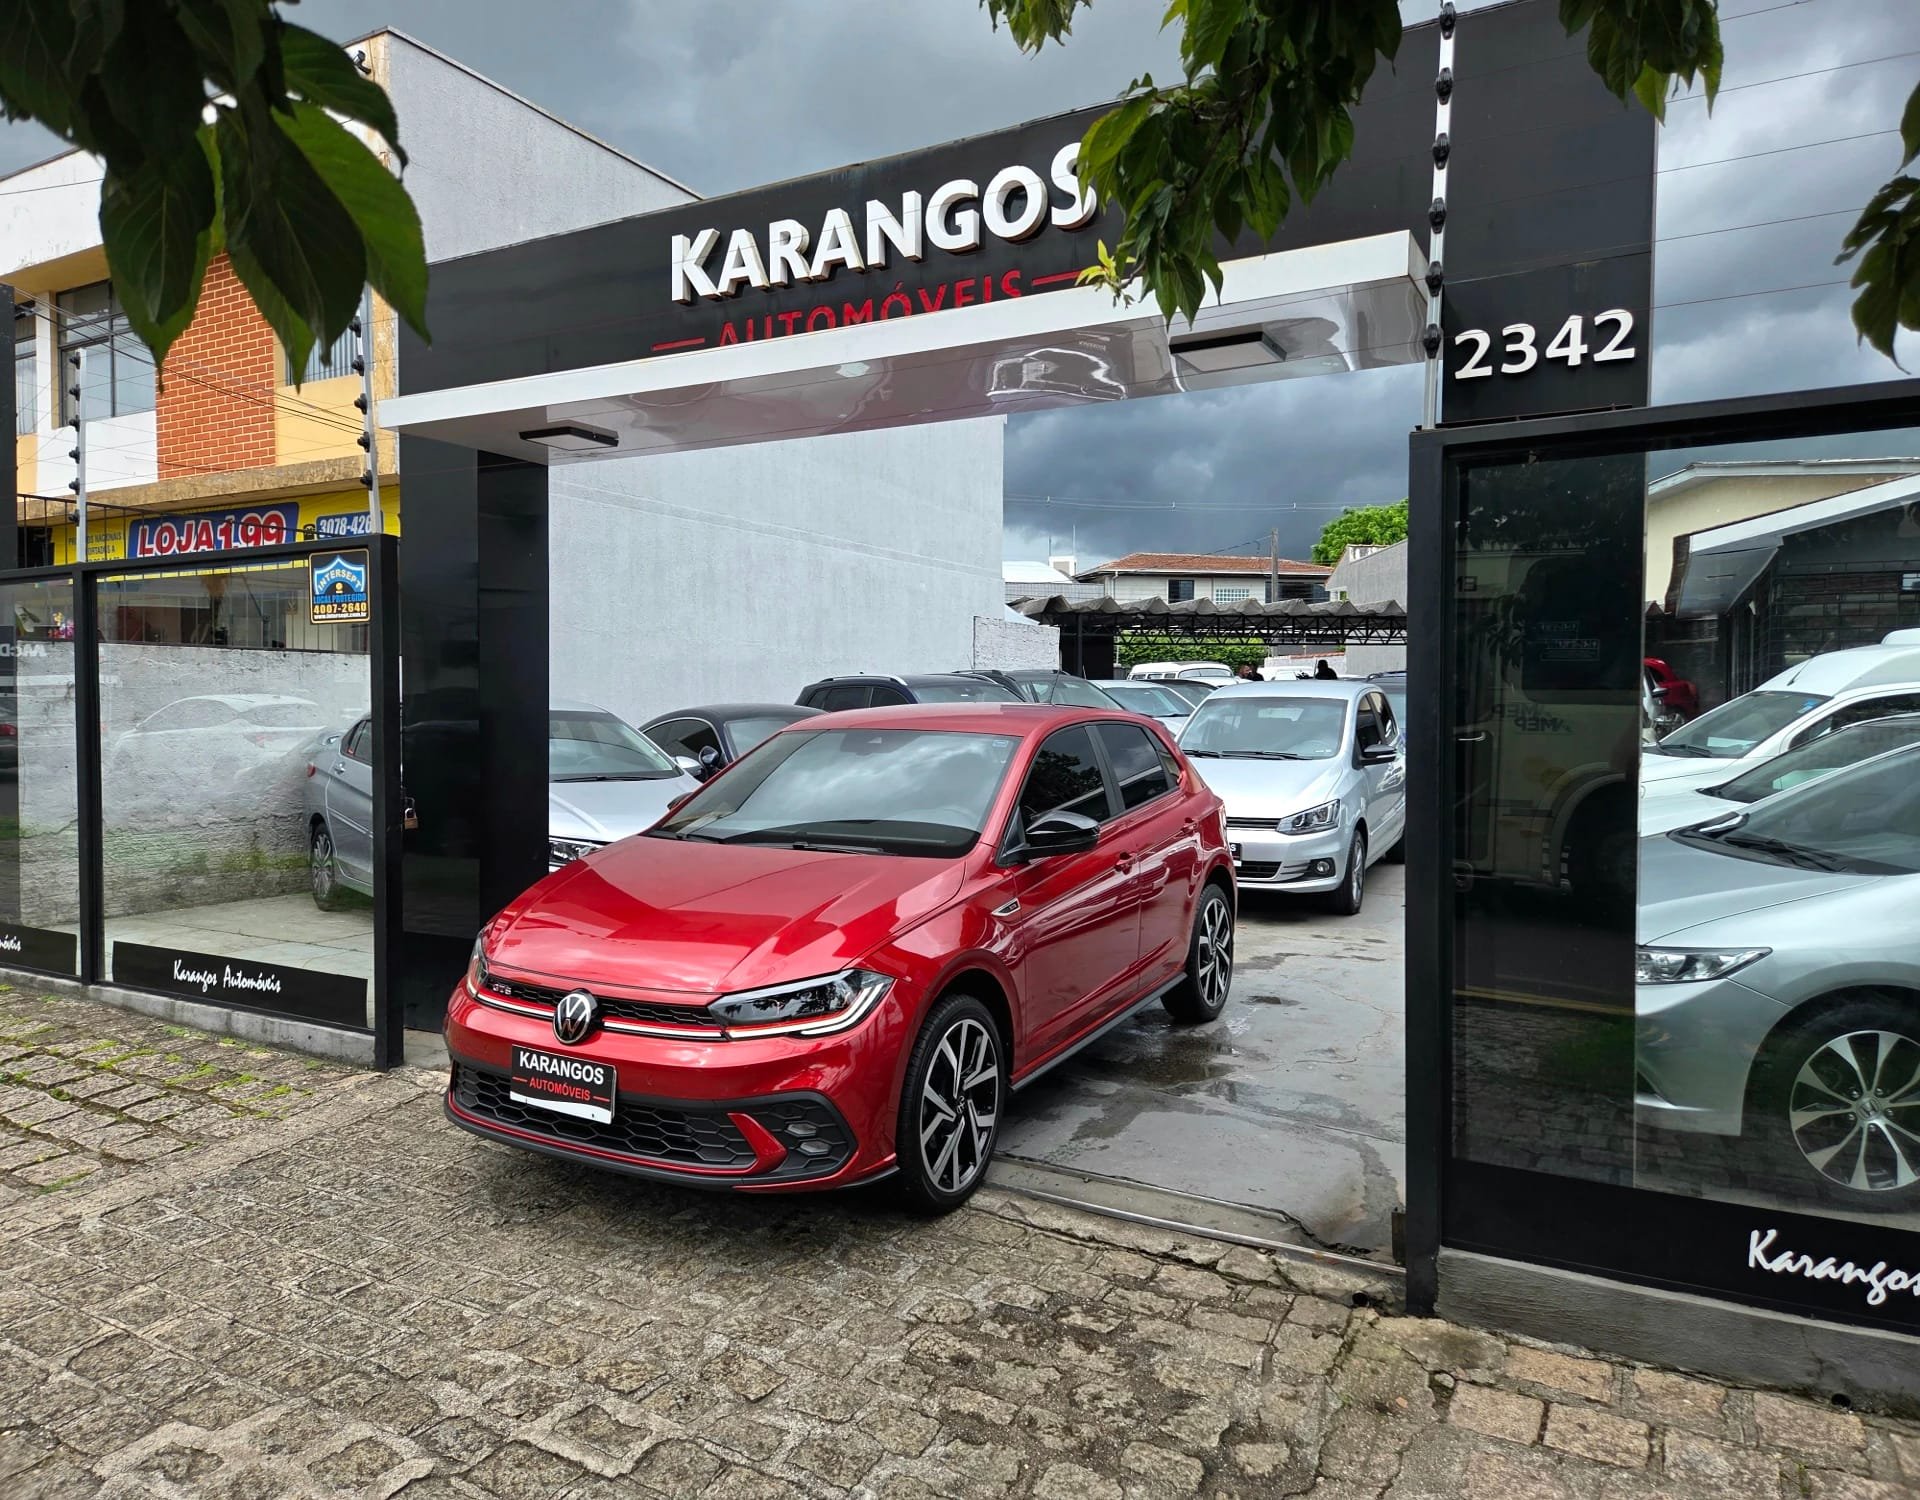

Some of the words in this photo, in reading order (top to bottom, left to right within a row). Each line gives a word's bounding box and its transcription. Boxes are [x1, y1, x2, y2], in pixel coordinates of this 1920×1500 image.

[671, 142, 1097, 302] KARANGOS
[1454, 308, 1635, 380] 2342
[137, 519, 215, 557] LOJA
[217, 510, 287, 549] 199
[319, 514, 373, 538] 3078-426
[317, 569, 362, 591] INTERSEPT
[313, 602, 367, 614] 4007-2640
[173, 959, 218, 992] Karangos
[223, 964, 281, 993] Automóveis
[519, 1051, 605, 1085] KARANGOS
[529, 1077, 591, 1101] AUTOMÓVEIS
